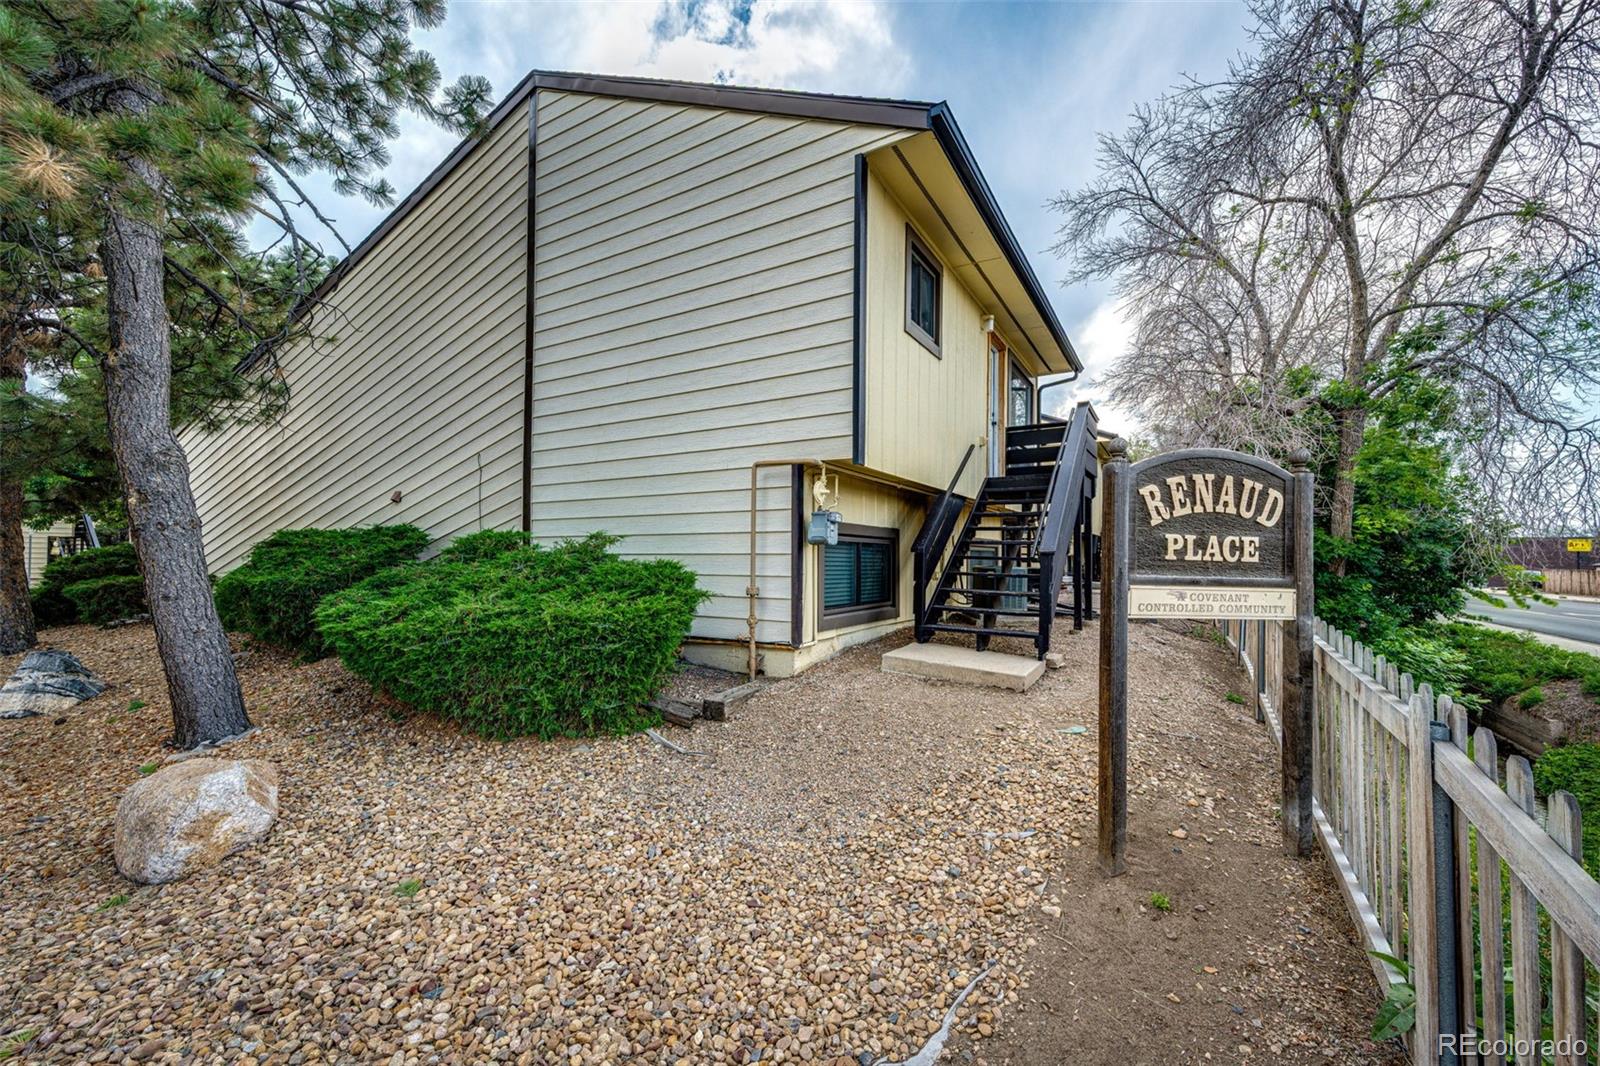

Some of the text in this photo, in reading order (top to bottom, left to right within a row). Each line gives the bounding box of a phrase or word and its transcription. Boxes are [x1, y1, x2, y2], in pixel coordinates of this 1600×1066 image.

[1137, 473, 1284, 527] RENAUD
[1165, 533, 1260, 563] PLACE
[1189, 592, 1250, 603] COVENANT
[1137, 603, 1286, 614] CONTROLLED COMMUNITY
